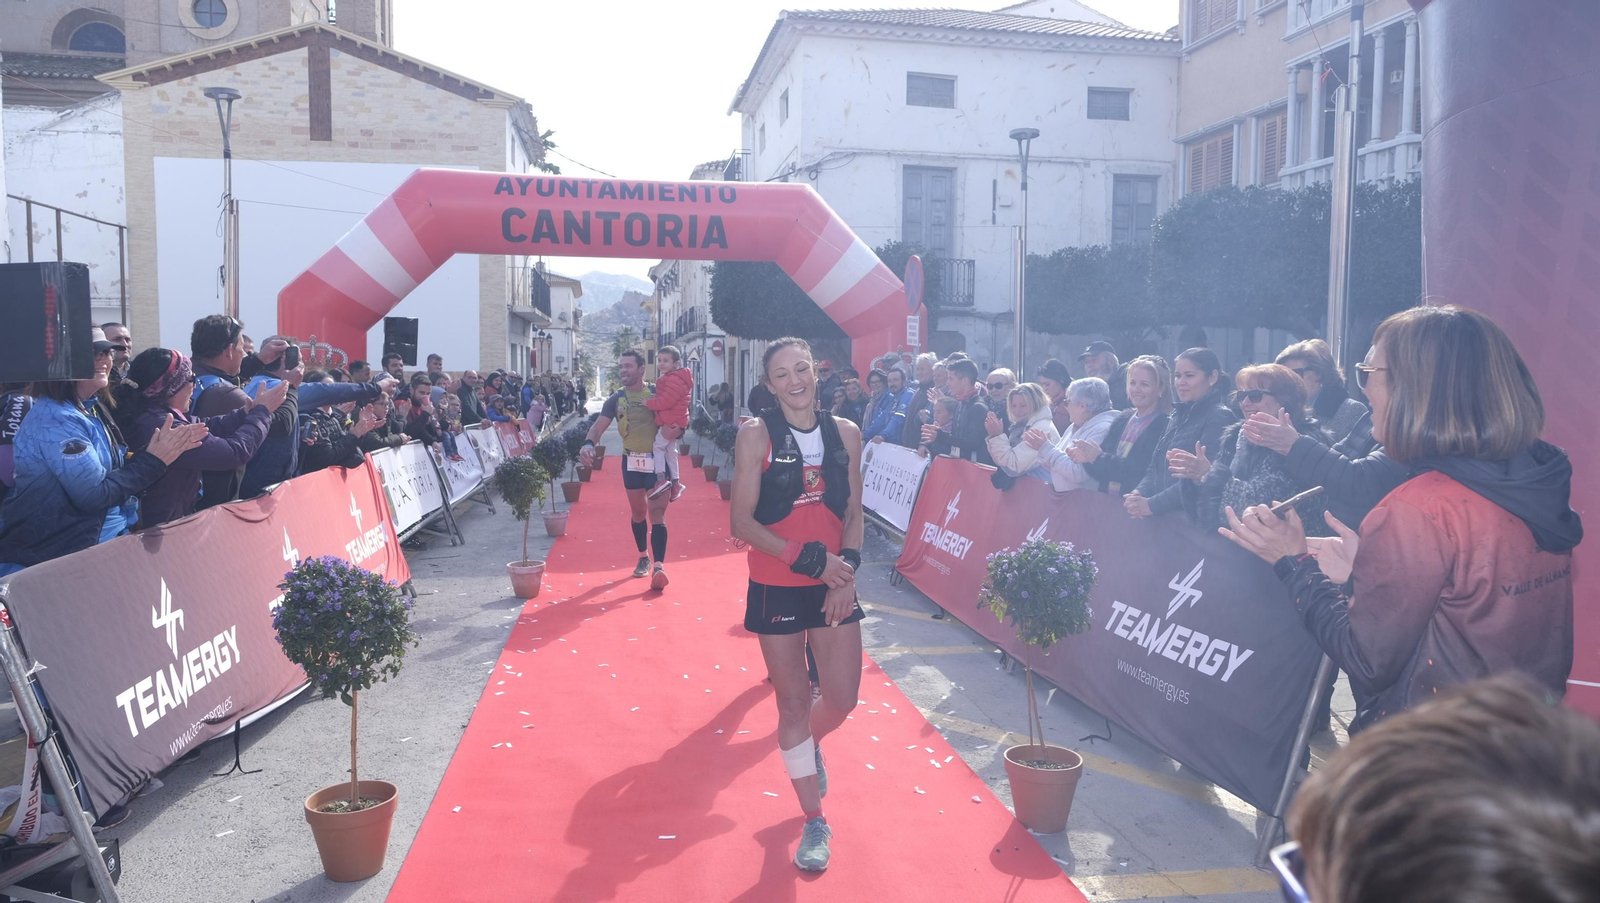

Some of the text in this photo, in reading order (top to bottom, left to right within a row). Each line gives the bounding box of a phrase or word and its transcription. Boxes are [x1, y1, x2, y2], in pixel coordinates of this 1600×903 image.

[494, 176, 737, 204] AYUNTAMIENTO
[501, 207, 729, 249] CANTORIA
[2, 395, 26, 438] Totana
[636, 459, 646, 467] 11
[911, 474, 918, 486] DE
[392, 473, 436, 508] CATORIA
[864, 469, 914, 511] CANTORIA
[345, 523, 386, 565] TEAMERG
[920, 521, 974, 560] TEAMERGY
[1501, 580, 1532, 597] VALLE
[1534, 576, 1543, 590] DE
[1104, 600, 1255, 683] TEAMERGY
[115, 624, 241, 738] TEAMERGY
[1117, 658, 1191, 705] www.teamergy.es
[169, 695, 234, 756] www.teamergy.es
[28, 790, 39, 808] EL
